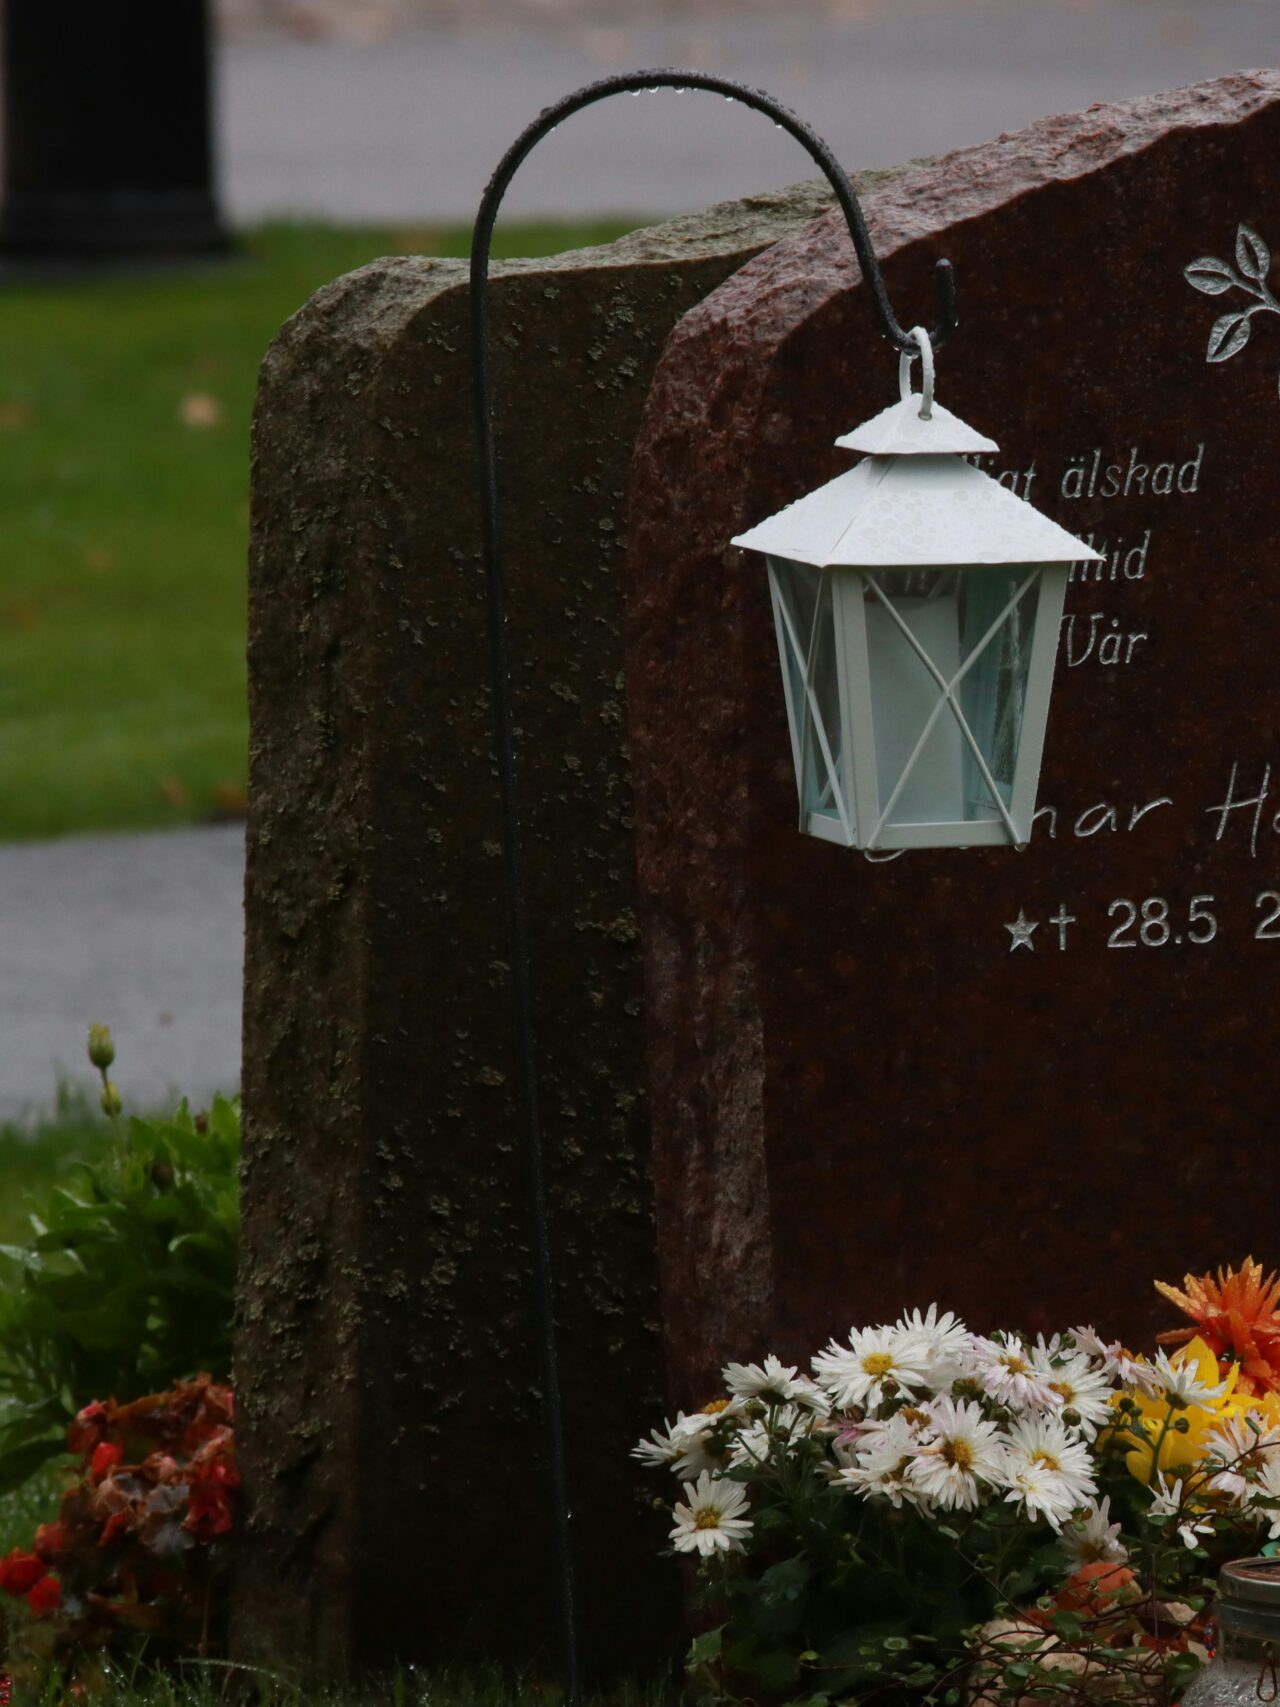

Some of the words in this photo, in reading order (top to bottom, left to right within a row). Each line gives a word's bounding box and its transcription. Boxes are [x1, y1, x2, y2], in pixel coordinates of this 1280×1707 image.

[1061, 443, 1205, 499] älskad
[1067, 529, 1152, 583] lltid
[1060, 611, 1149, 667] Vår
[1032, 797, 1174, 840] nar
[1106, 894, 1218, 949] 28.5
